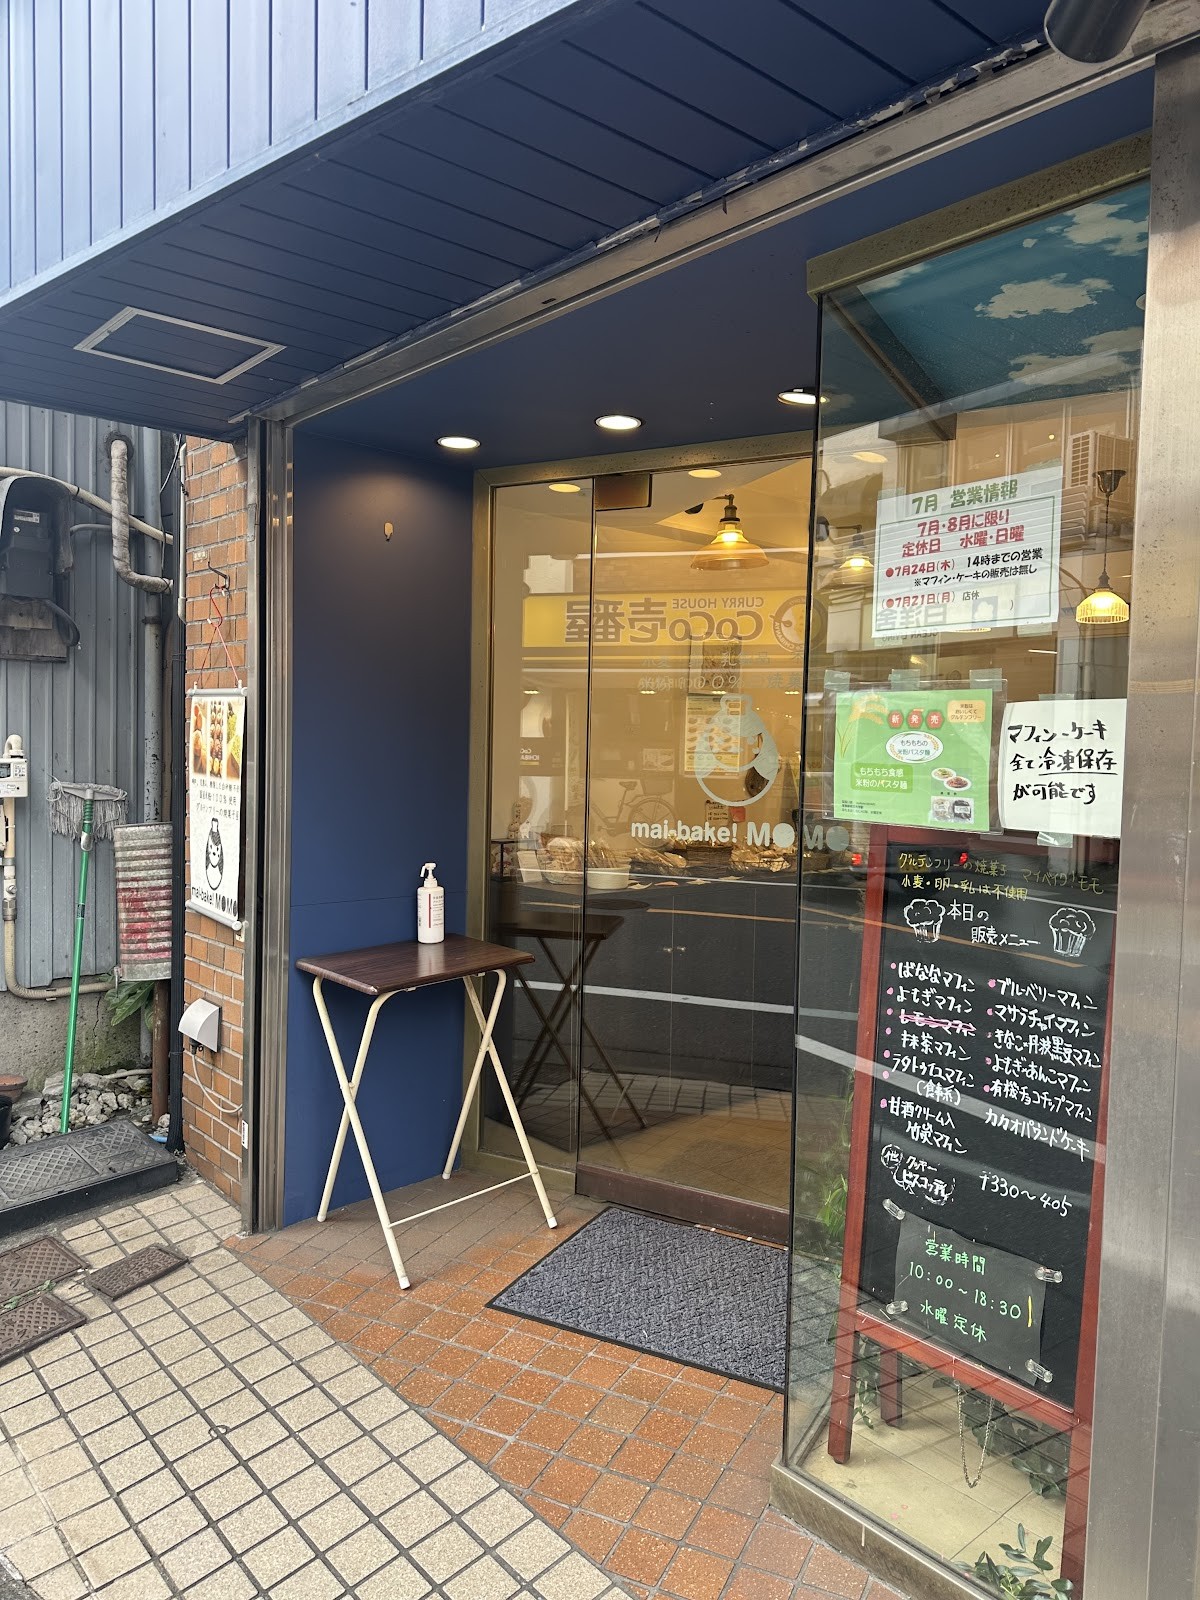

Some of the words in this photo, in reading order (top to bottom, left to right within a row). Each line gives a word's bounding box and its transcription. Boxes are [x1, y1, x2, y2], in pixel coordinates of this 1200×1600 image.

[912, 494, 938, 514] 7月
[950, 479, 1018, 508] 営業情報
[917, 509, 1010, 537] 7月・8月に限り
[902, 538, 941, 557] 定休日
[960, 525, 1024, 548] 水曜・日曜
[967, 547, 1043, 568] 14時までの営業
[962, 590, 979, 601] 店休
[891, 713, 940, 725] 新発売
[859, 767, 904, 777] もちもち食感
[1010, 746, 1118, 772] 全て冷凍保存
[1013, 781, 1096, 805] が可能です
[631, 820, 737, 843] mai-bake!
[901, 873, 1029, 902] 小麦・卵・乳は不使用
[947, 899, 990, 922] 本日の
[970, 925, 1041, 947] 販売メニュー
[898, 961, 976, 993] ばななマフィン
[896, 985, 973, 1014] よもぎマフィン
[996, 977, 1098, 1010] ブルーベリーマフィン
[994, 1004, 1096, 1038] マサラチャイマフィン
[900, 1029, 972, 1061] 抹茶マフィン
[888, 1096, 956, 1129] 甘酒クリーム入
[989, 1078, 1093, 1122] 有機チョコチップマフィン
[905, 1120, 968, 1154] 竹炭マフィン
[984, 1107, 1090, 1162] カカオパウンドケーキ
[925, 1239, 986, 1276] 営業時間
